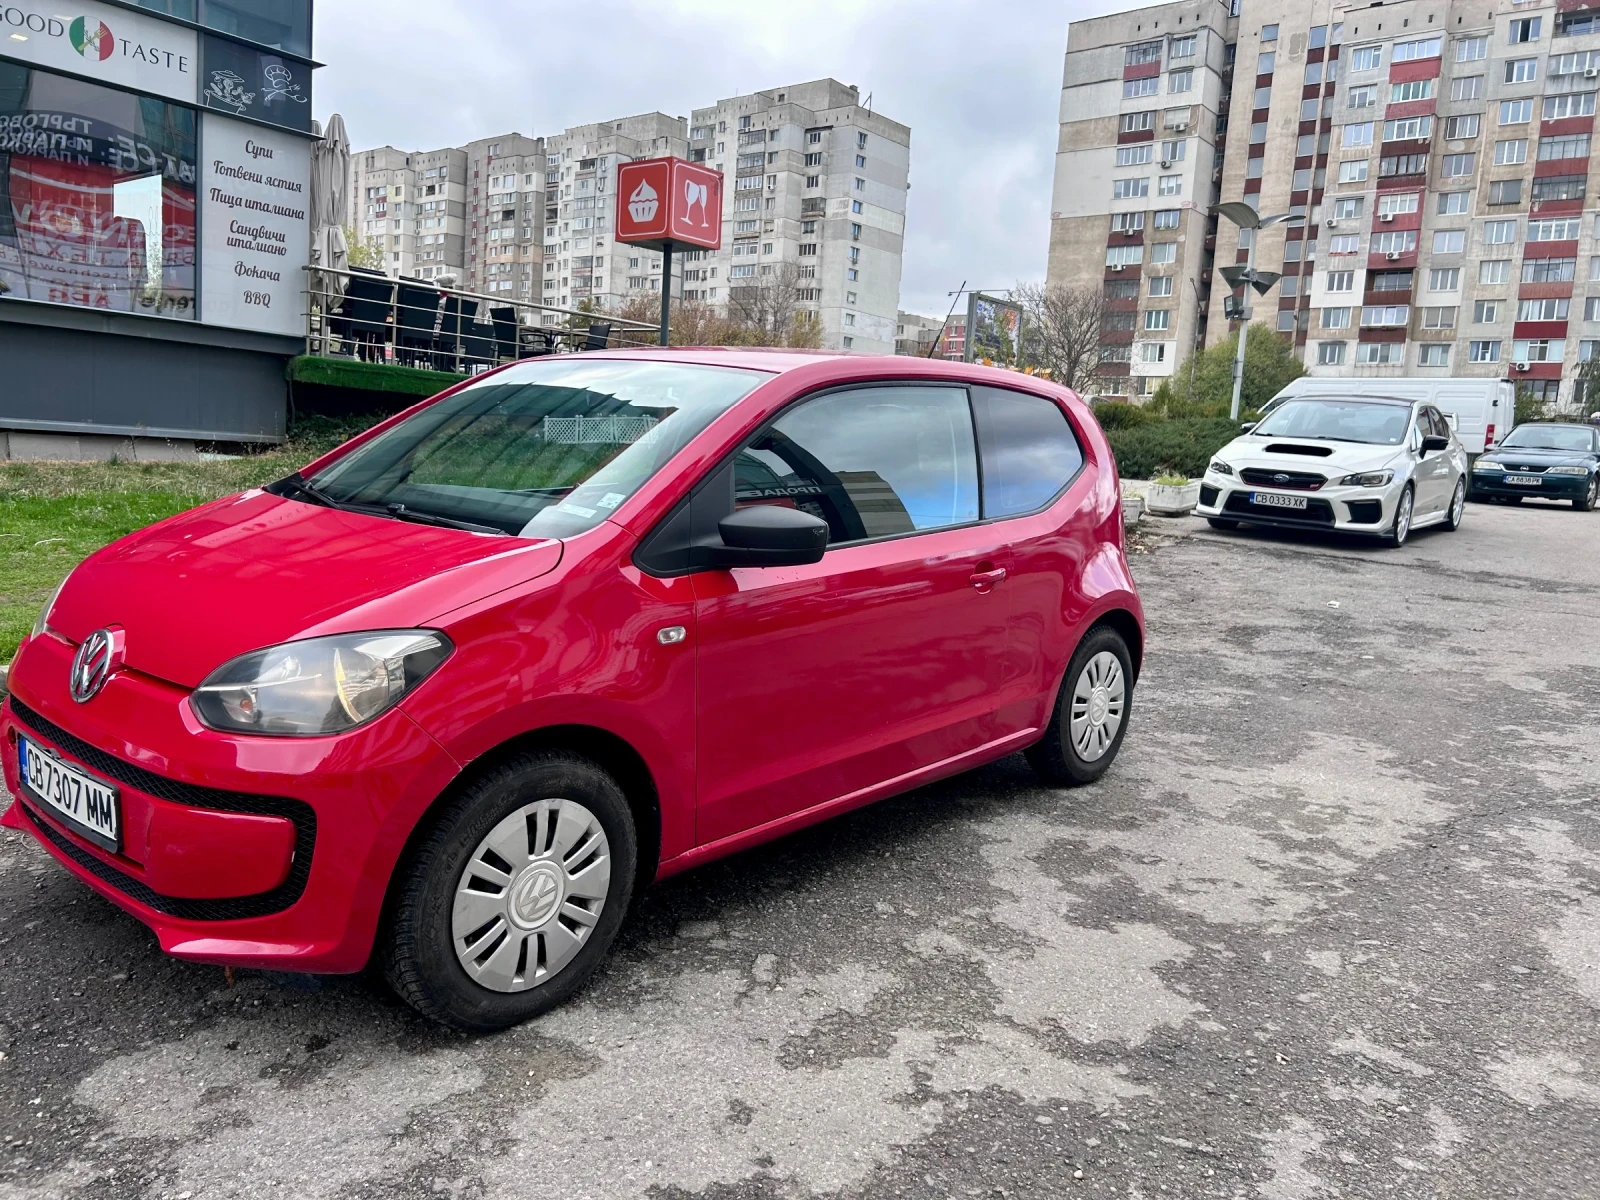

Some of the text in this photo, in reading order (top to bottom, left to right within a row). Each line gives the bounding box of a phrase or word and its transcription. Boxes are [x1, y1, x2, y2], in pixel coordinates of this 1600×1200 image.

[0, 5, 188, 73] OOD TASTE
[245, 139, 273, 159] Супи
[213, 160, 263, 184] Готвени
[264, 176, 302, 193] ястия
[209, 187, 305, 221] Пица италиана
[229, 219, 286, 243] Сандвичи
[226, 236, 287, 256] италиано
[234, 260, 280, 282] Фокача
[243, 290, 271, 308] BBQ
[1255, 494, 1305, 508] CB 0333 XK
[27, 748, 113, 833] CB 7307 MM
